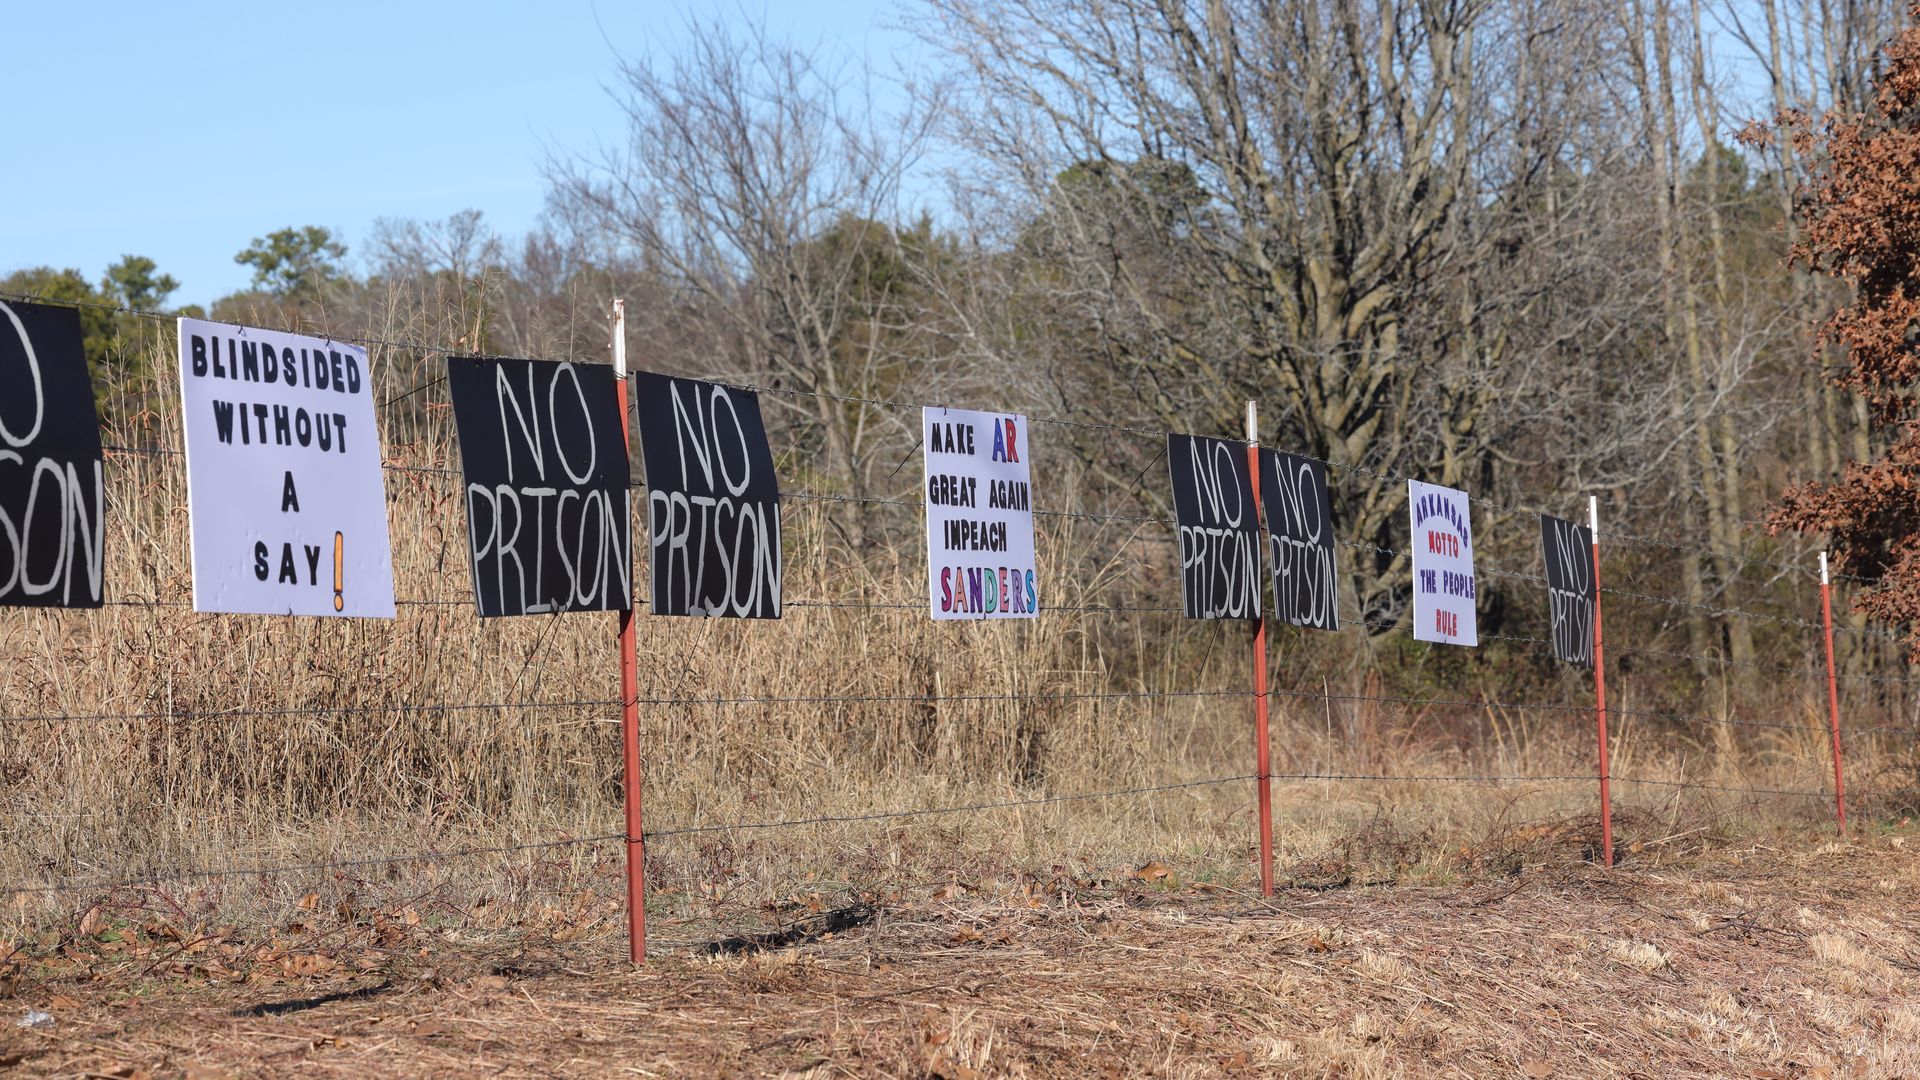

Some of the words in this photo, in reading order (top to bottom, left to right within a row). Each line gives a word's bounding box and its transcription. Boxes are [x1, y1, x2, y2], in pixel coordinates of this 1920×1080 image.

[191, 334, 361, 395] BLINDSIDED
[212, 399, 347, 453] WITHOUT
[496, 362, 596, 485] NO
[670, 380, 750, 497] NO
[931, 422, 976, 455] MAKE
[992, 417, 1019, 463] AR
[281, 471, 300, 512] A
[929, 474, 977, 508] GREAT
[989, 479, 1029, 512] AGAIN
[1190, 435, 1242, 528] NO
[1274, 452, 1322, 545] NO
[468, 482, 632, 617] PRISON
[650, 489, 783, 619] PRISON
[944, 519, 1008, 552] IMPEACH
[1416, 493, 1469, 549] ARKANSAS
[1428, 530, 1459, 559] MOTTO
[254, 530, 344, 612] SAY!
[940, 566, 1037, 614] SANDERS
[1180, 525, 1262, 620] PRISON
[1270, 533, 1340, 631] PRISON
[1420, 569, 1437, 594] THE
[1443, 570, 1475, 600] PEOPLE
[1554, 519, 1589, 596] NO
[1436, 608, 1458, 637] RULE
[1550, 587, 1597, 668] PRISON
